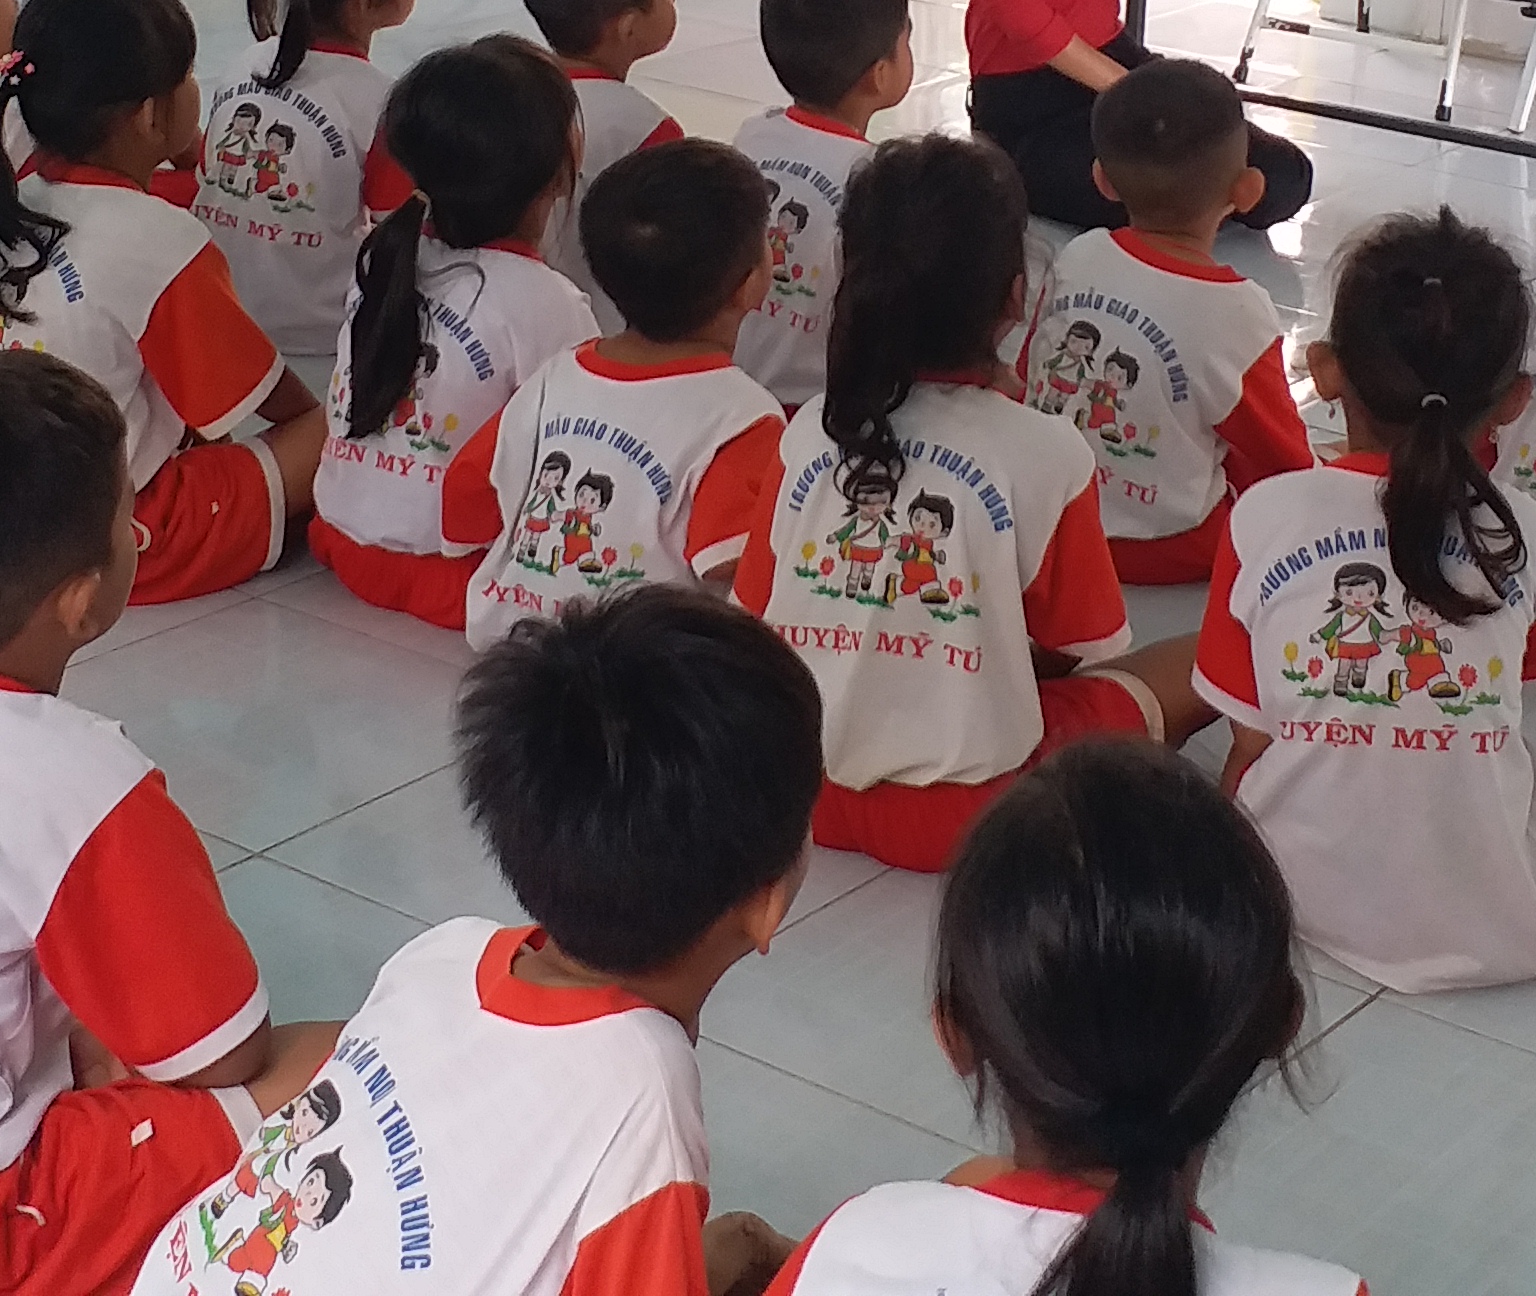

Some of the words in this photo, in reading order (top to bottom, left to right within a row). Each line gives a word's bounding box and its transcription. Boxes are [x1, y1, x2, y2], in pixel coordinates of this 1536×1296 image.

[573, 417, 608, 441] GIÁO
[608, 426, 655, 469] THUẬN
[929, 443, 986, 489] THUẬN
[424, 463, 446, 484] T
[876, 631, 934, 659] MỸ
[944, 643, 982, 674] TÚ
[1279, 716, 1377, 748] UYỆN
[1392, 723, 1459, 751] MỸ
[376, 1100, 425, 1192] THUẬN
[399, 1194, 435, 1271] HƯNG
